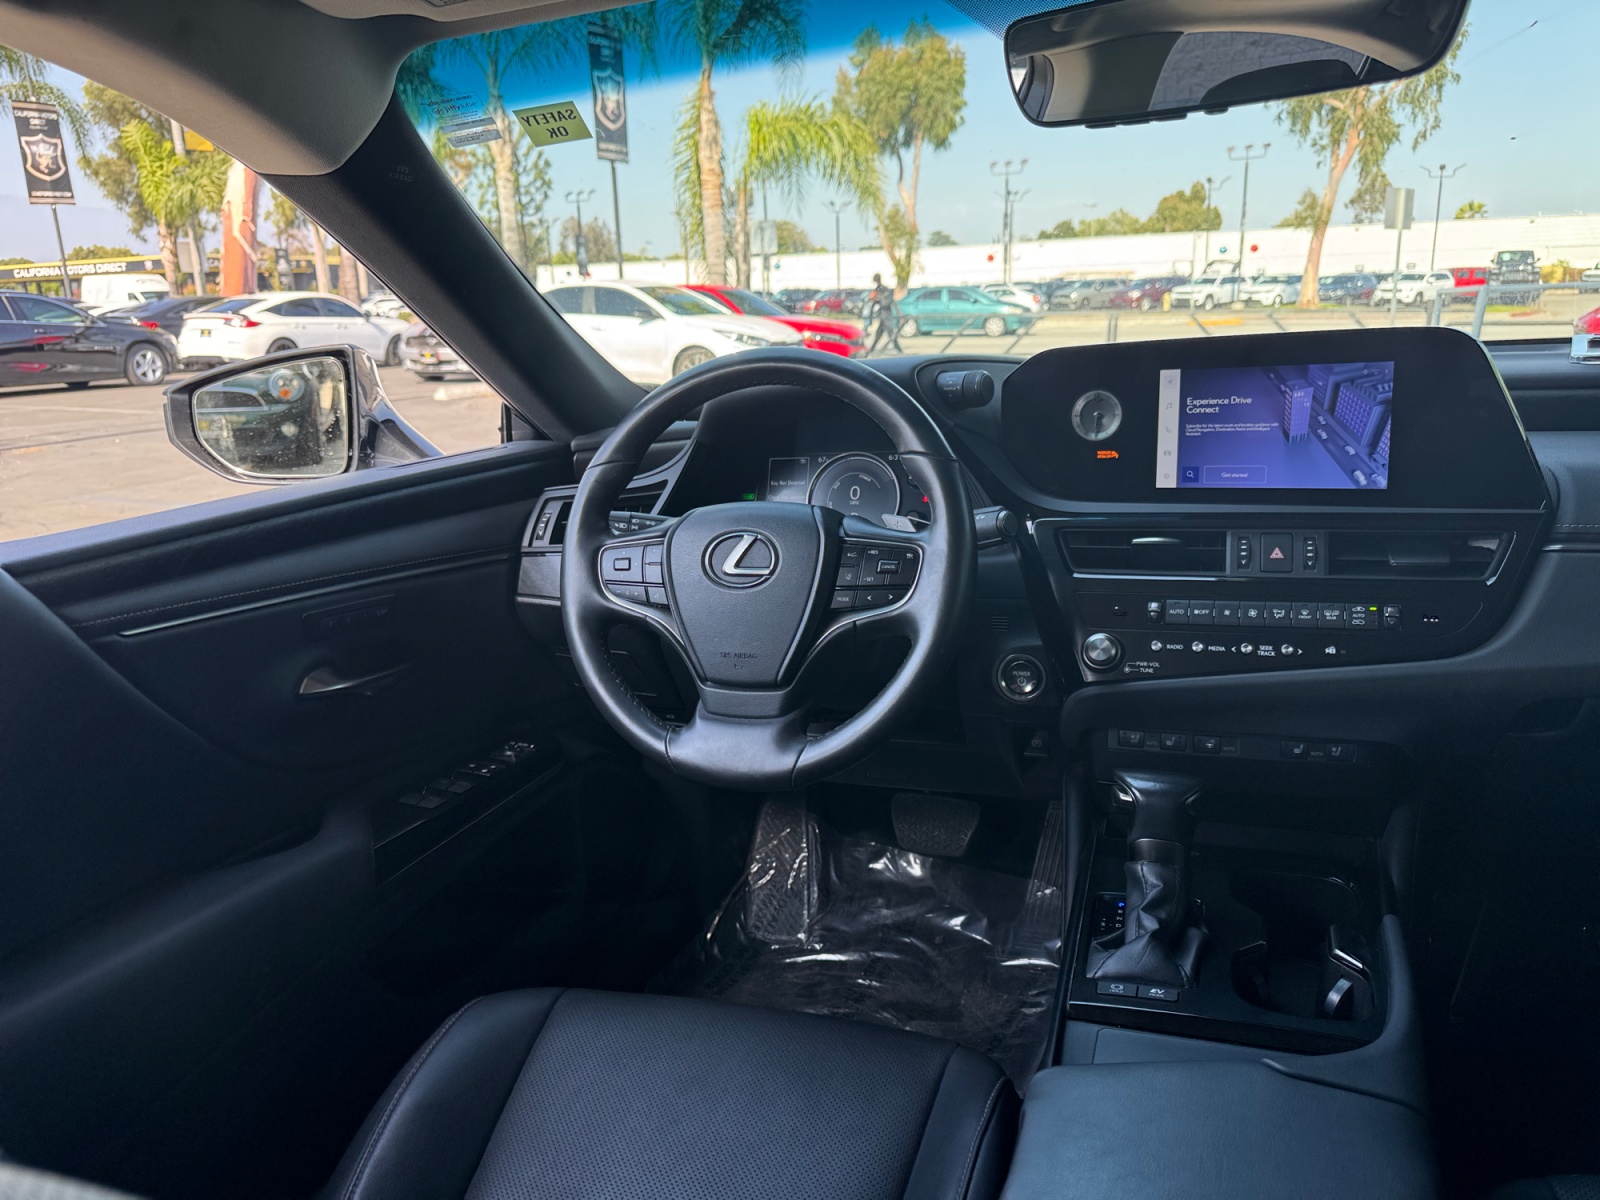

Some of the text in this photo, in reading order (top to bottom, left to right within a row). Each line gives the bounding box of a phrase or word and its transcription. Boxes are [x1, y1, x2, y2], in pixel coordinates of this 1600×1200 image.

[13, 266, 61, 278] CALIFORNIA
[95, 262, 127, 273] DIRECT
[1186, 396, 1252, 407] Experience Drive
[1186, 406, 1220, 414] Connect
[850, 485, 860, 500] 0
[733, 652, 758, 660] AIRBAG
